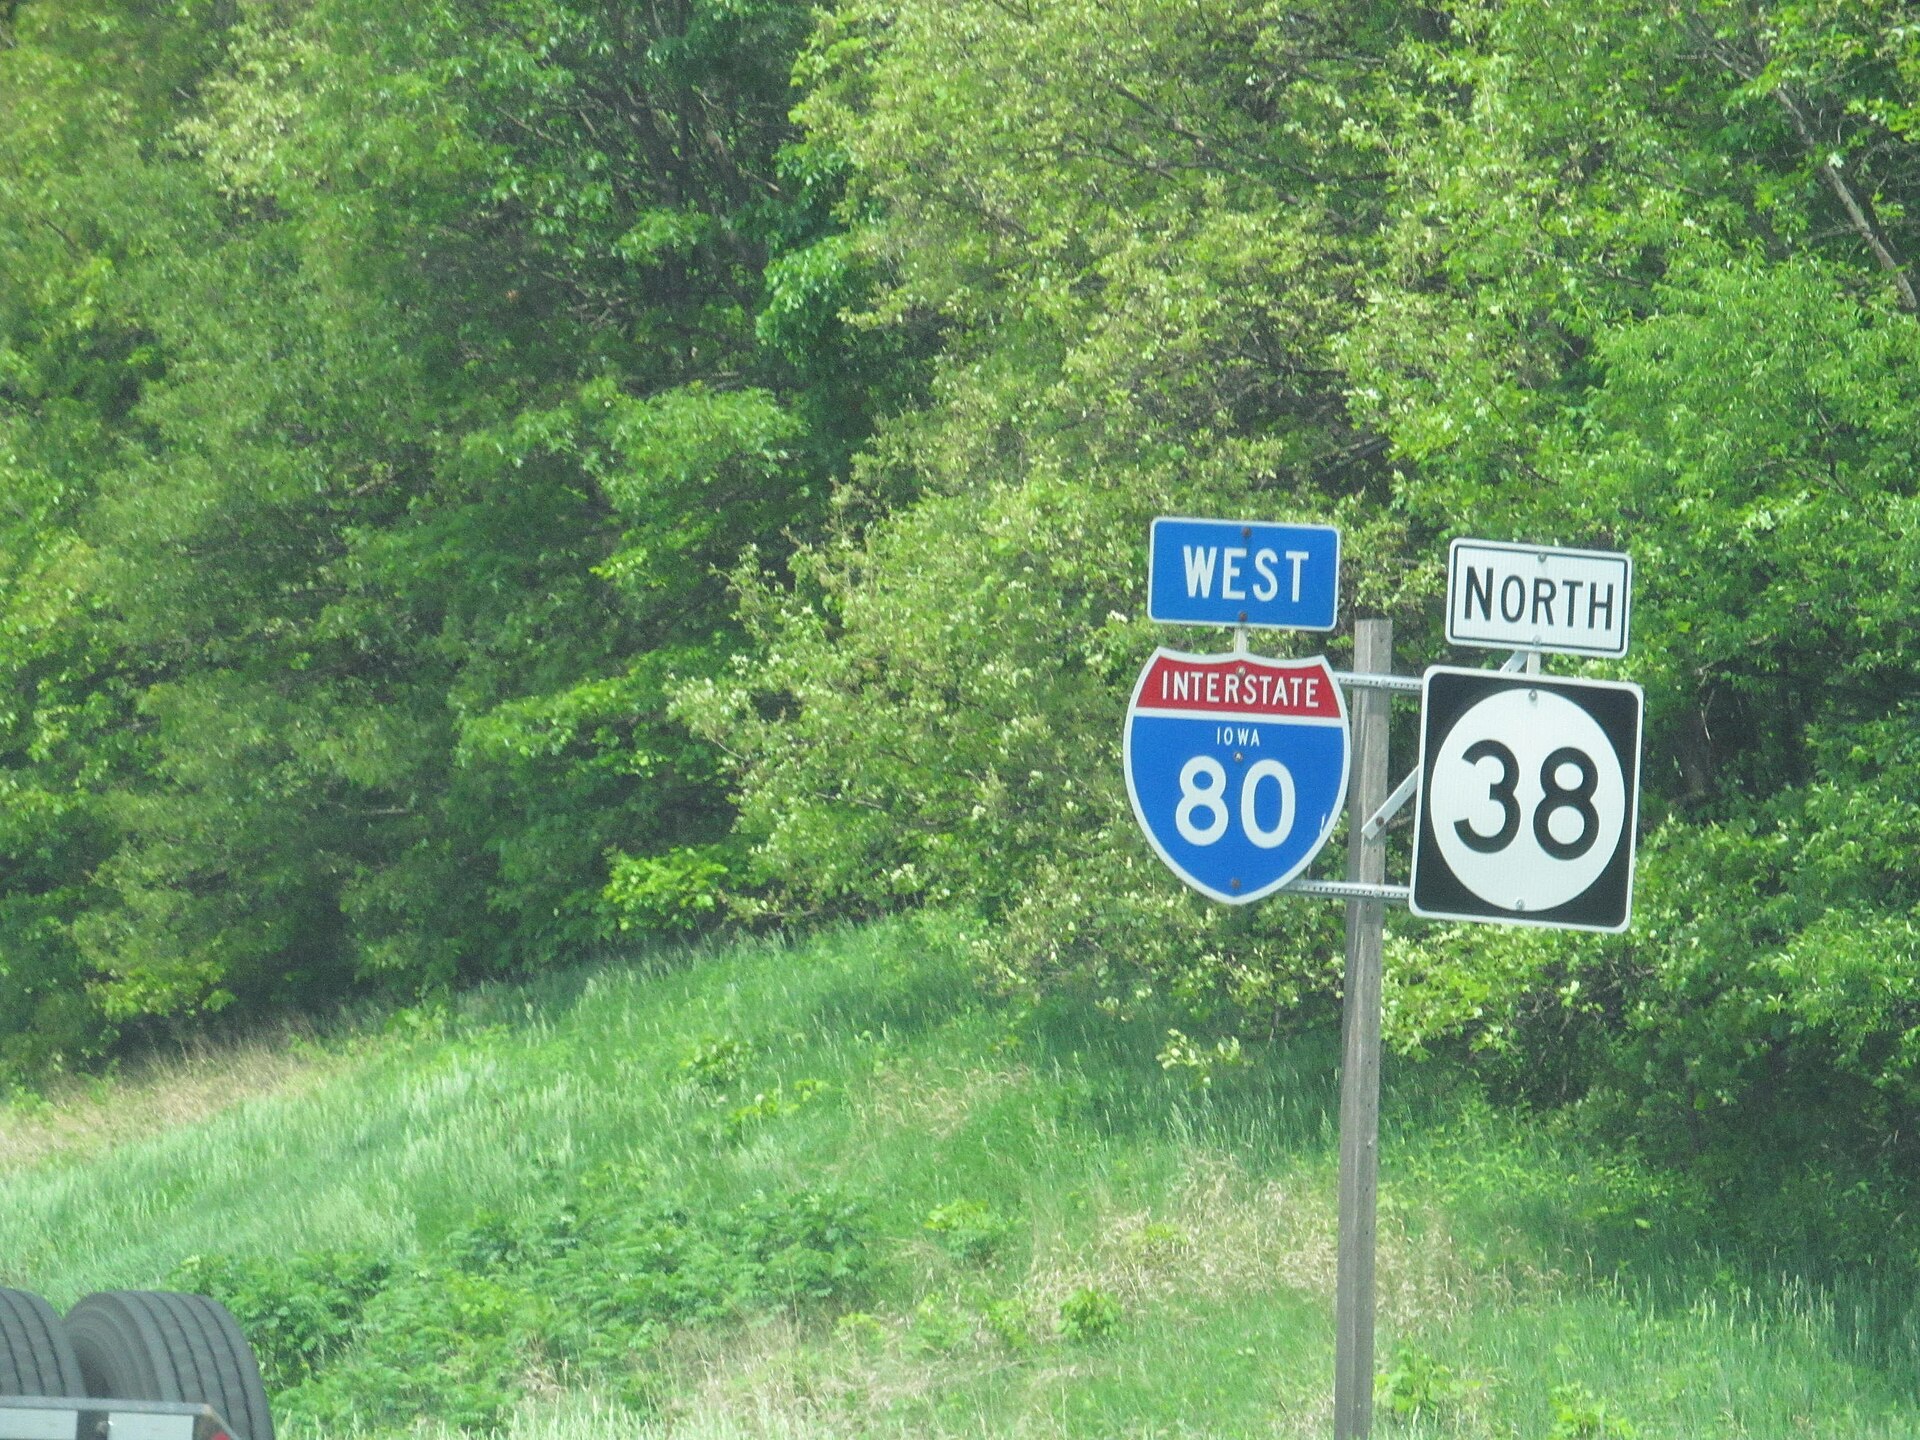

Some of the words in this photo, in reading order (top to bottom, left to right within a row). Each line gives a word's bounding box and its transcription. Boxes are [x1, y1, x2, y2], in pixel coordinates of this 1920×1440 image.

[1183, 545, 1309, 602] WEST
[1464, 566, 1614, 630] NORTH
[1162, 671, 1319, 708] INTERSTATE
[1216, 726, 1260, 747] IOWA
[1175, 755, 1296, 849] 80
[1453, 739, 1600, 860] 38
